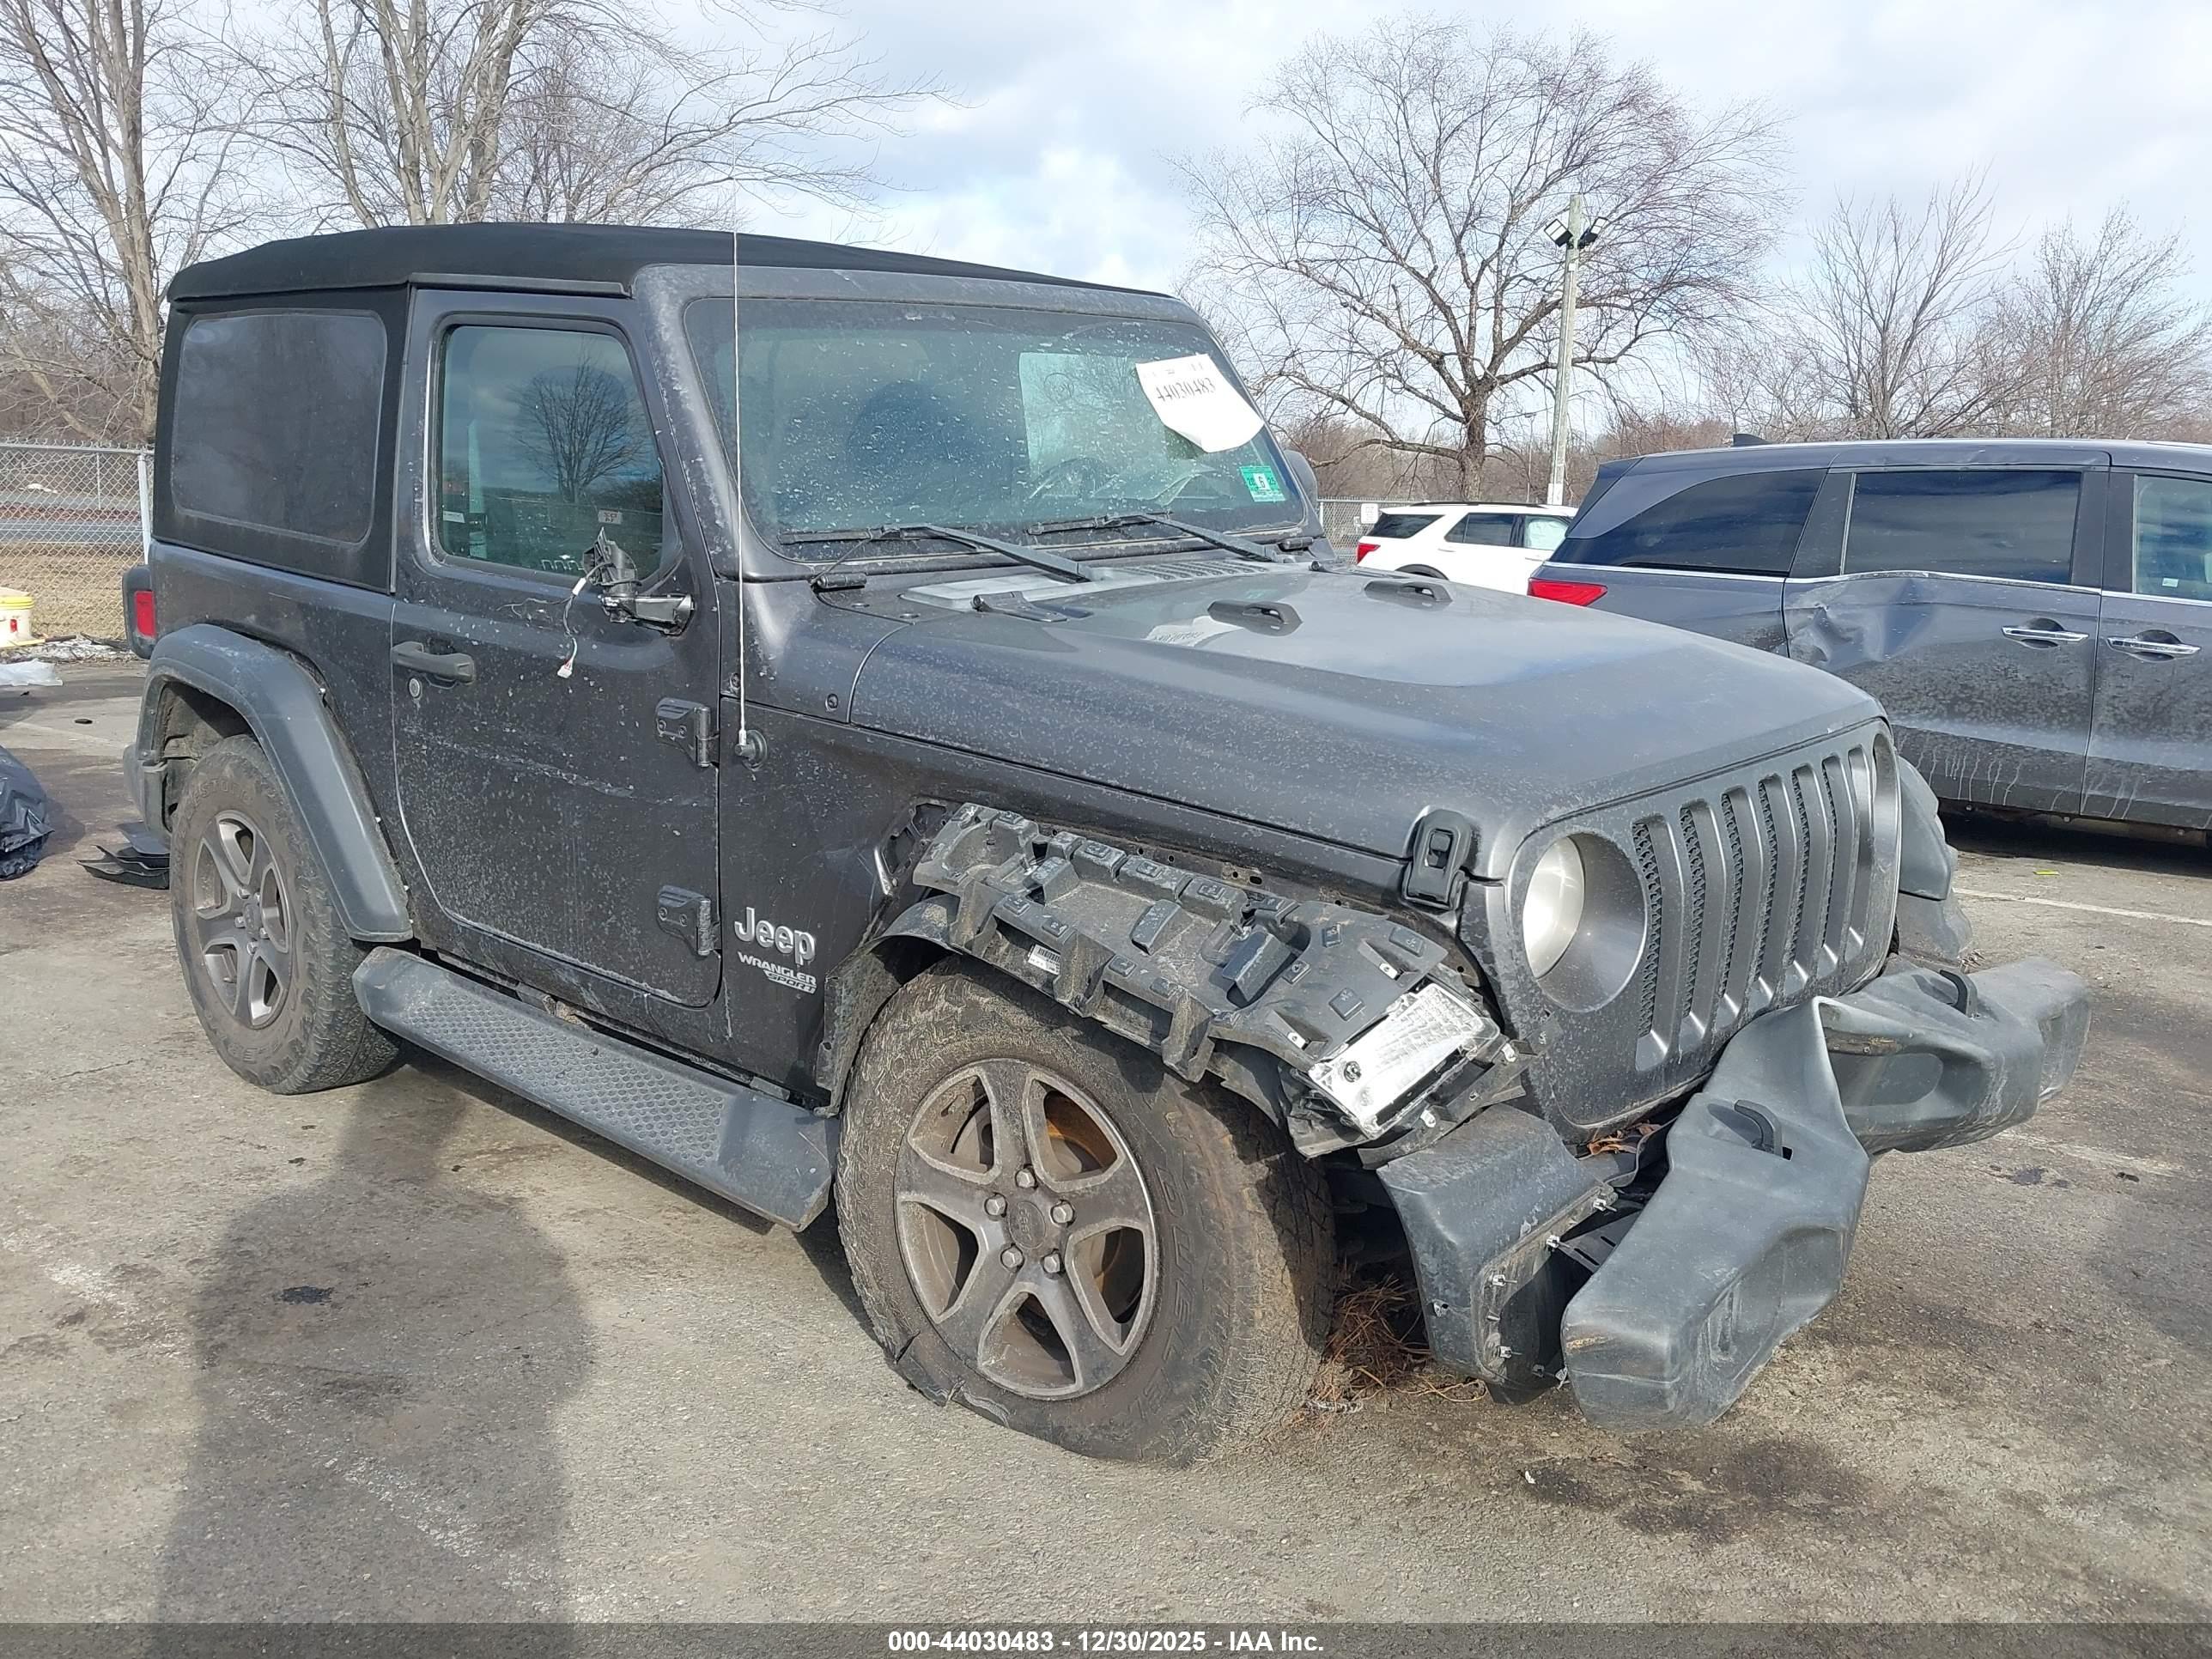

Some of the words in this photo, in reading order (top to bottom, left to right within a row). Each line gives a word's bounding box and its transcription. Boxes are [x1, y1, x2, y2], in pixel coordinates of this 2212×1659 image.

[1156, 378, 1216, 402] 44030483
[734, 906, 816, 966] Jeep
[737, 951, 817, 986] WRANGLER
[768, 971, 816, 994] SPORT
